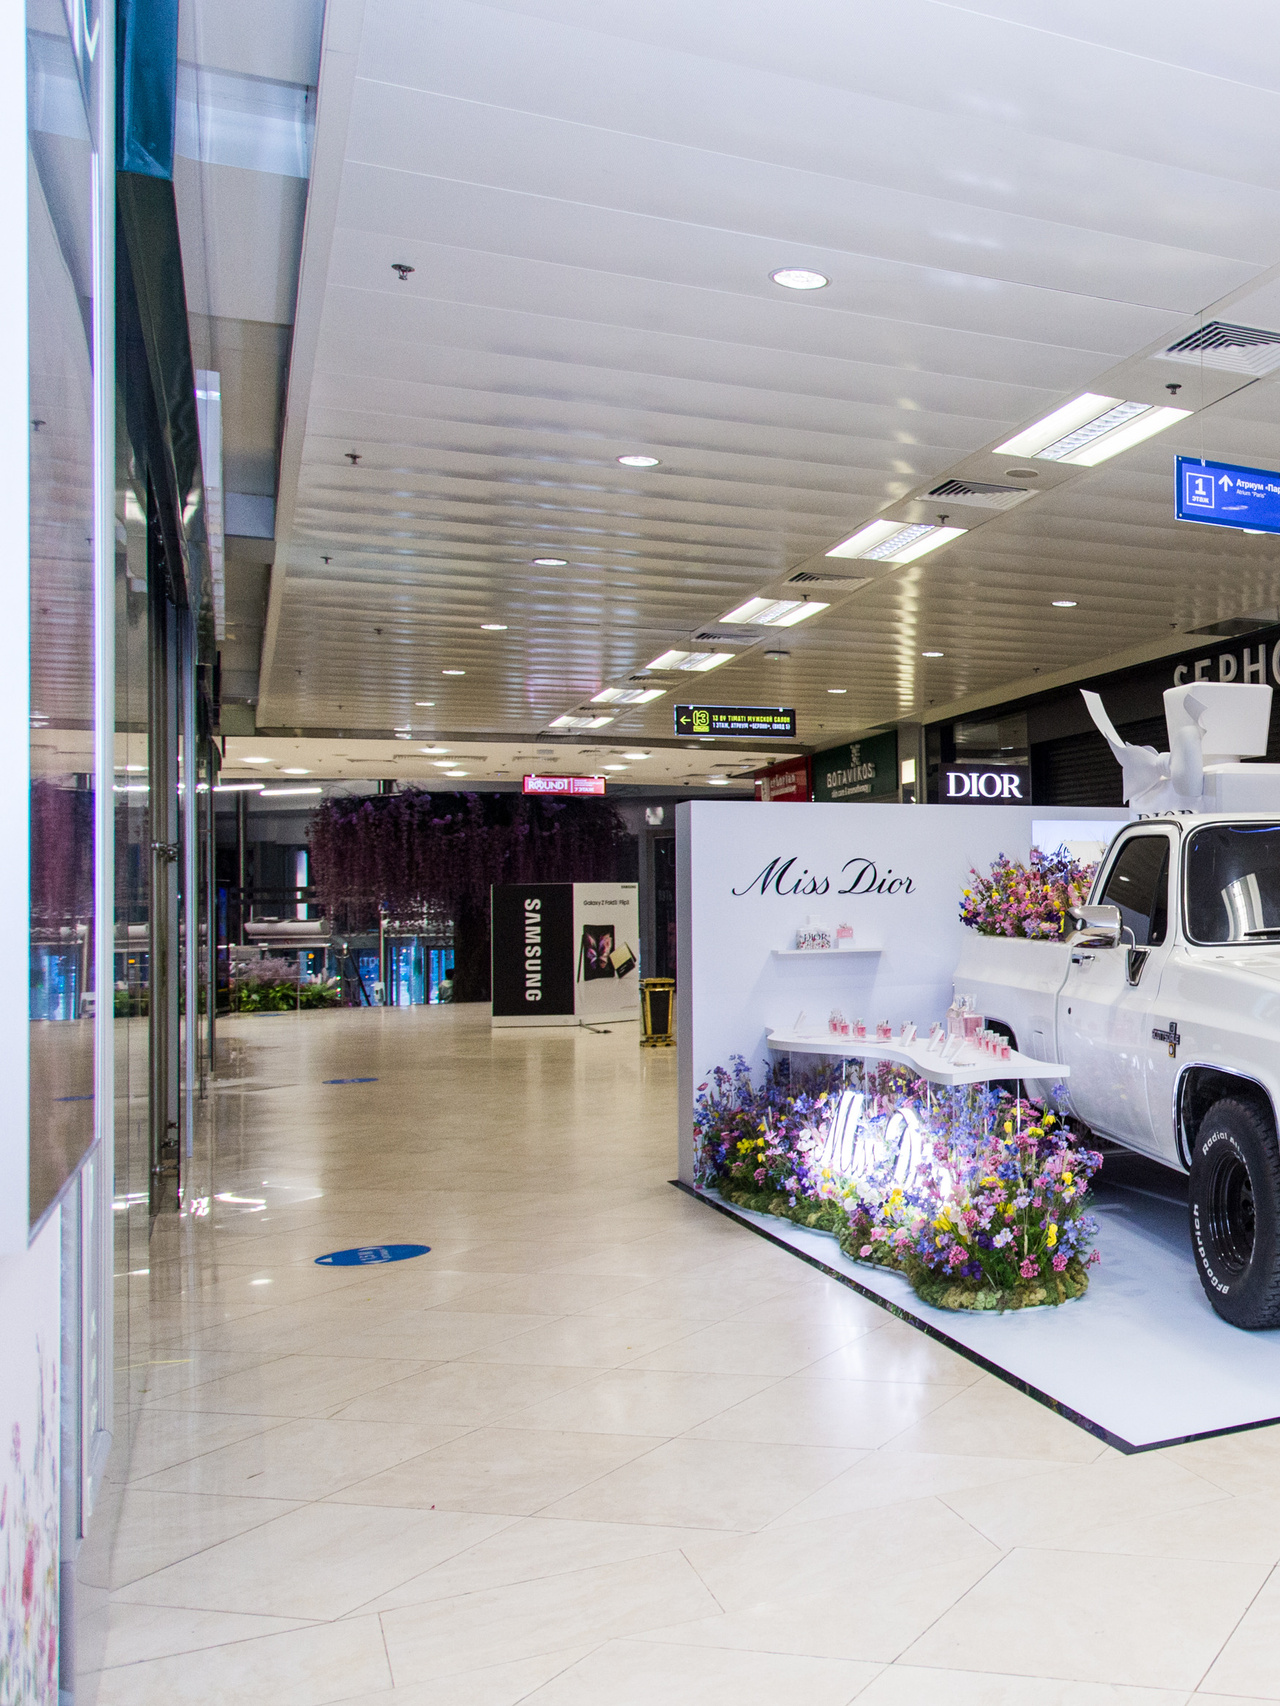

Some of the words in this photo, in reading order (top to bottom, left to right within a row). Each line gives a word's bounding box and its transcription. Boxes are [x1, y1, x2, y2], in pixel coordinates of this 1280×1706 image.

[1194, 478, 1206, 495] 1
[1236, 479, 1264, 491] Атриум
[1192, 496, 1210, 504] этаж
[946, 772, 1024, 798] DIOR
[732, 856, 830, 896] Miss
[838, 857, 916, 895] Dior
[524, 898, 542, 1002] SAMSUNG
[1202, 1131, 1228, 1156] Radial
[1193, 1204, 1229, 1294] BFGoodrich
